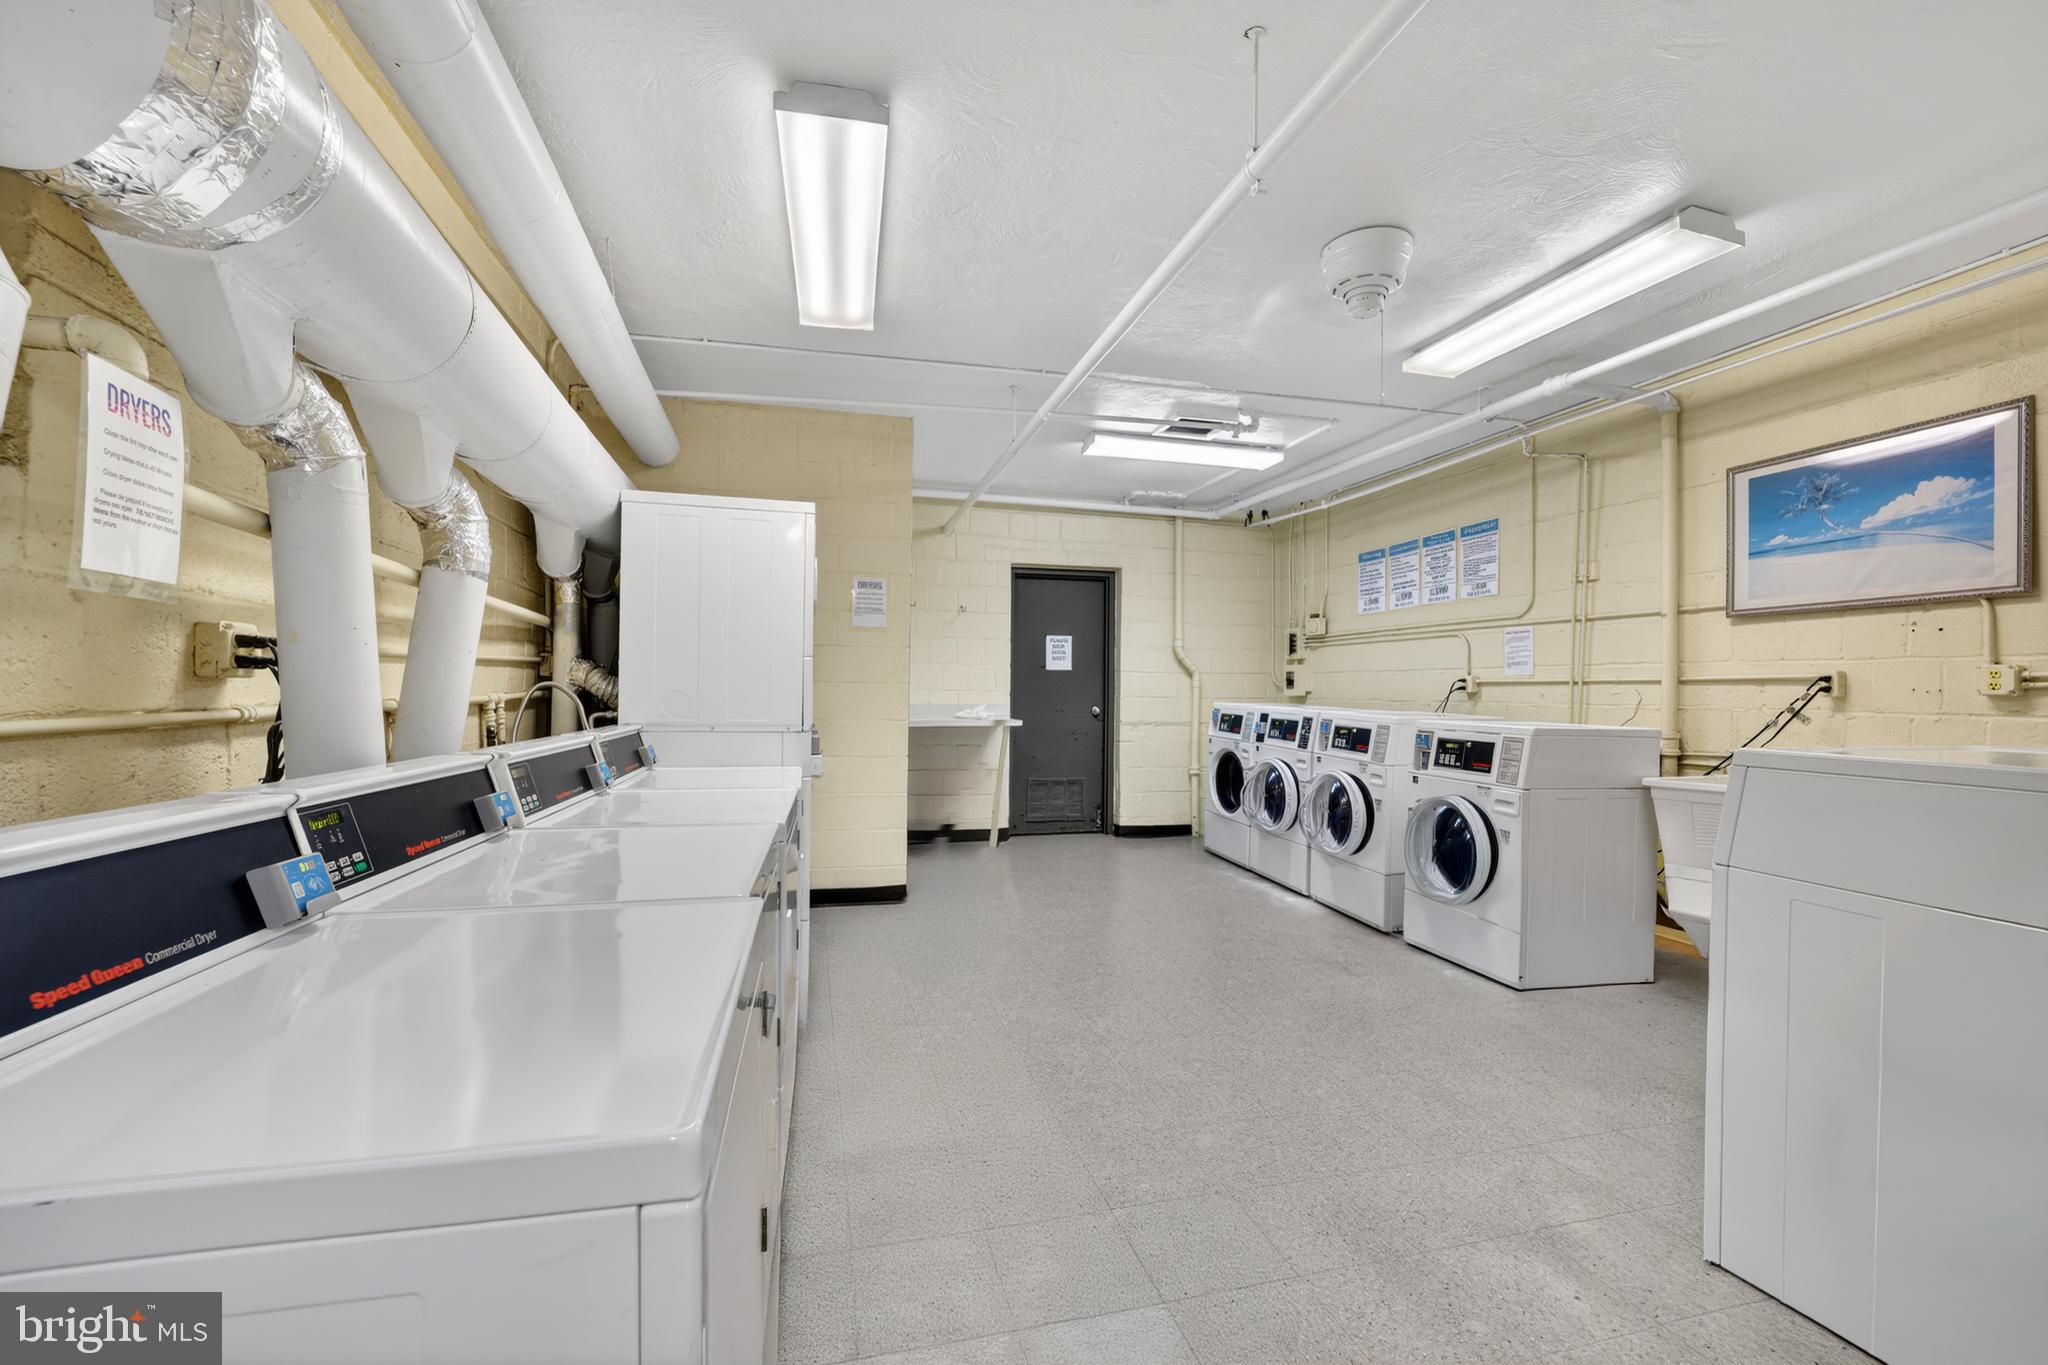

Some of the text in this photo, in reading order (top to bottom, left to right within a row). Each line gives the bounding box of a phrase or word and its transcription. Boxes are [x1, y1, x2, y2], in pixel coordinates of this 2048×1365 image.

[108, 382, 171, 437] DRYERS
[30, 930, 218, 1010] Speed Queen Commercial Dryer
